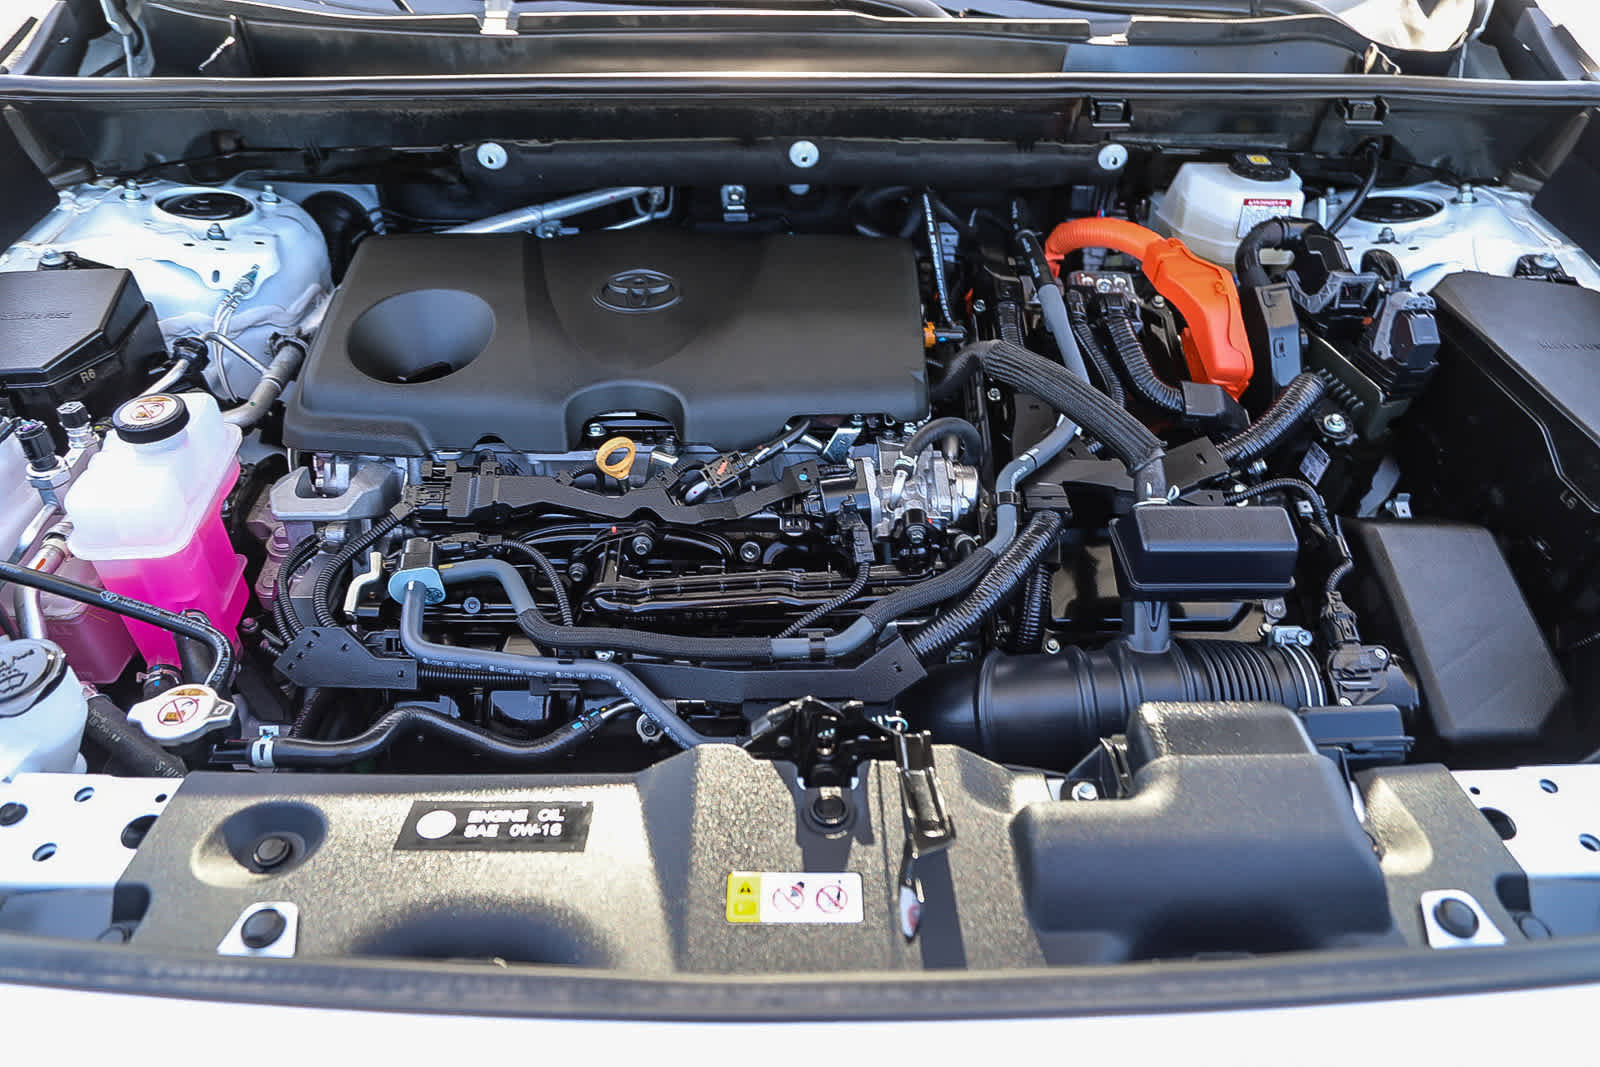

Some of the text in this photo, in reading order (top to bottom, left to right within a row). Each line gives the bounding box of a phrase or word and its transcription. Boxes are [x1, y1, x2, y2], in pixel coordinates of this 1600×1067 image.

[80, 369, 96, 383] R6
[467, 808, 565, 823] ENGINE OIL
[463, 823, 562, 838] SAE 0W-16
